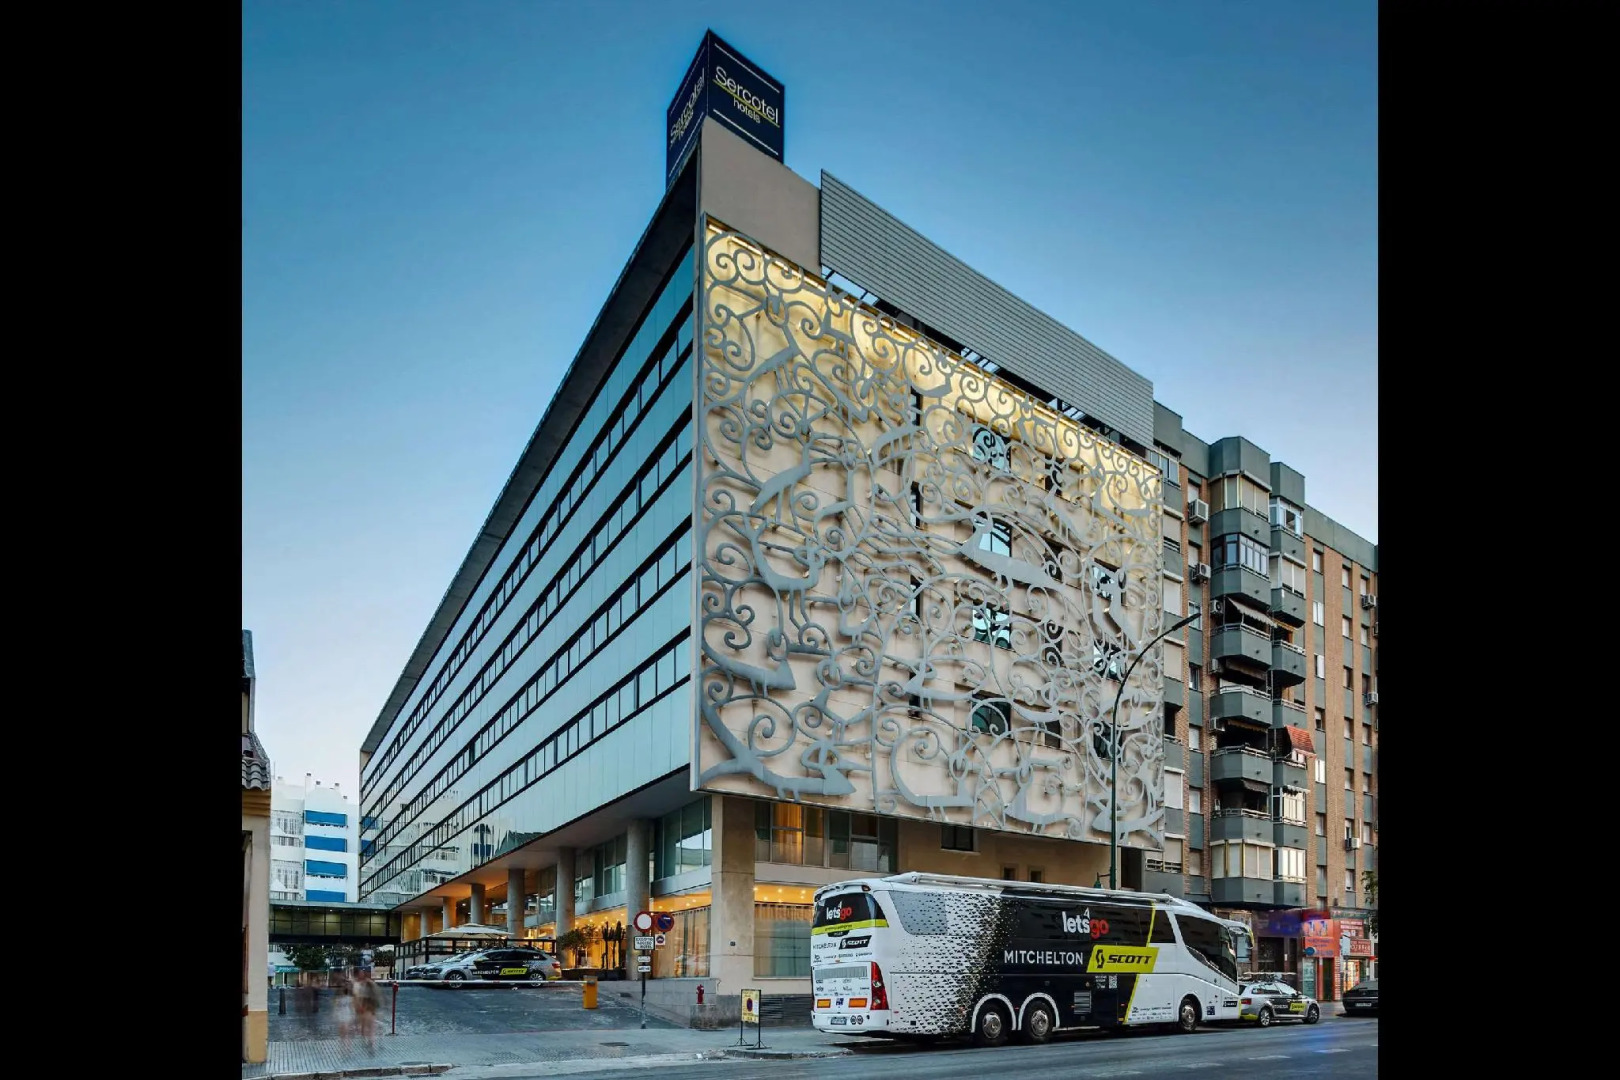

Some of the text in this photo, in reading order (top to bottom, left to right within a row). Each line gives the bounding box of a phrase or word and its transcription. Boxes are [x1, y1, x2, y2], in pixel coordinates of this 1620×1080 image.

[715, 66, 778, 123] Sercotel
[733, 97, 760, 124] hotels
[846, 938, 868, 946] SCOTT
[1004, 950, 1153, 965] MITCHELTON SCOTT
